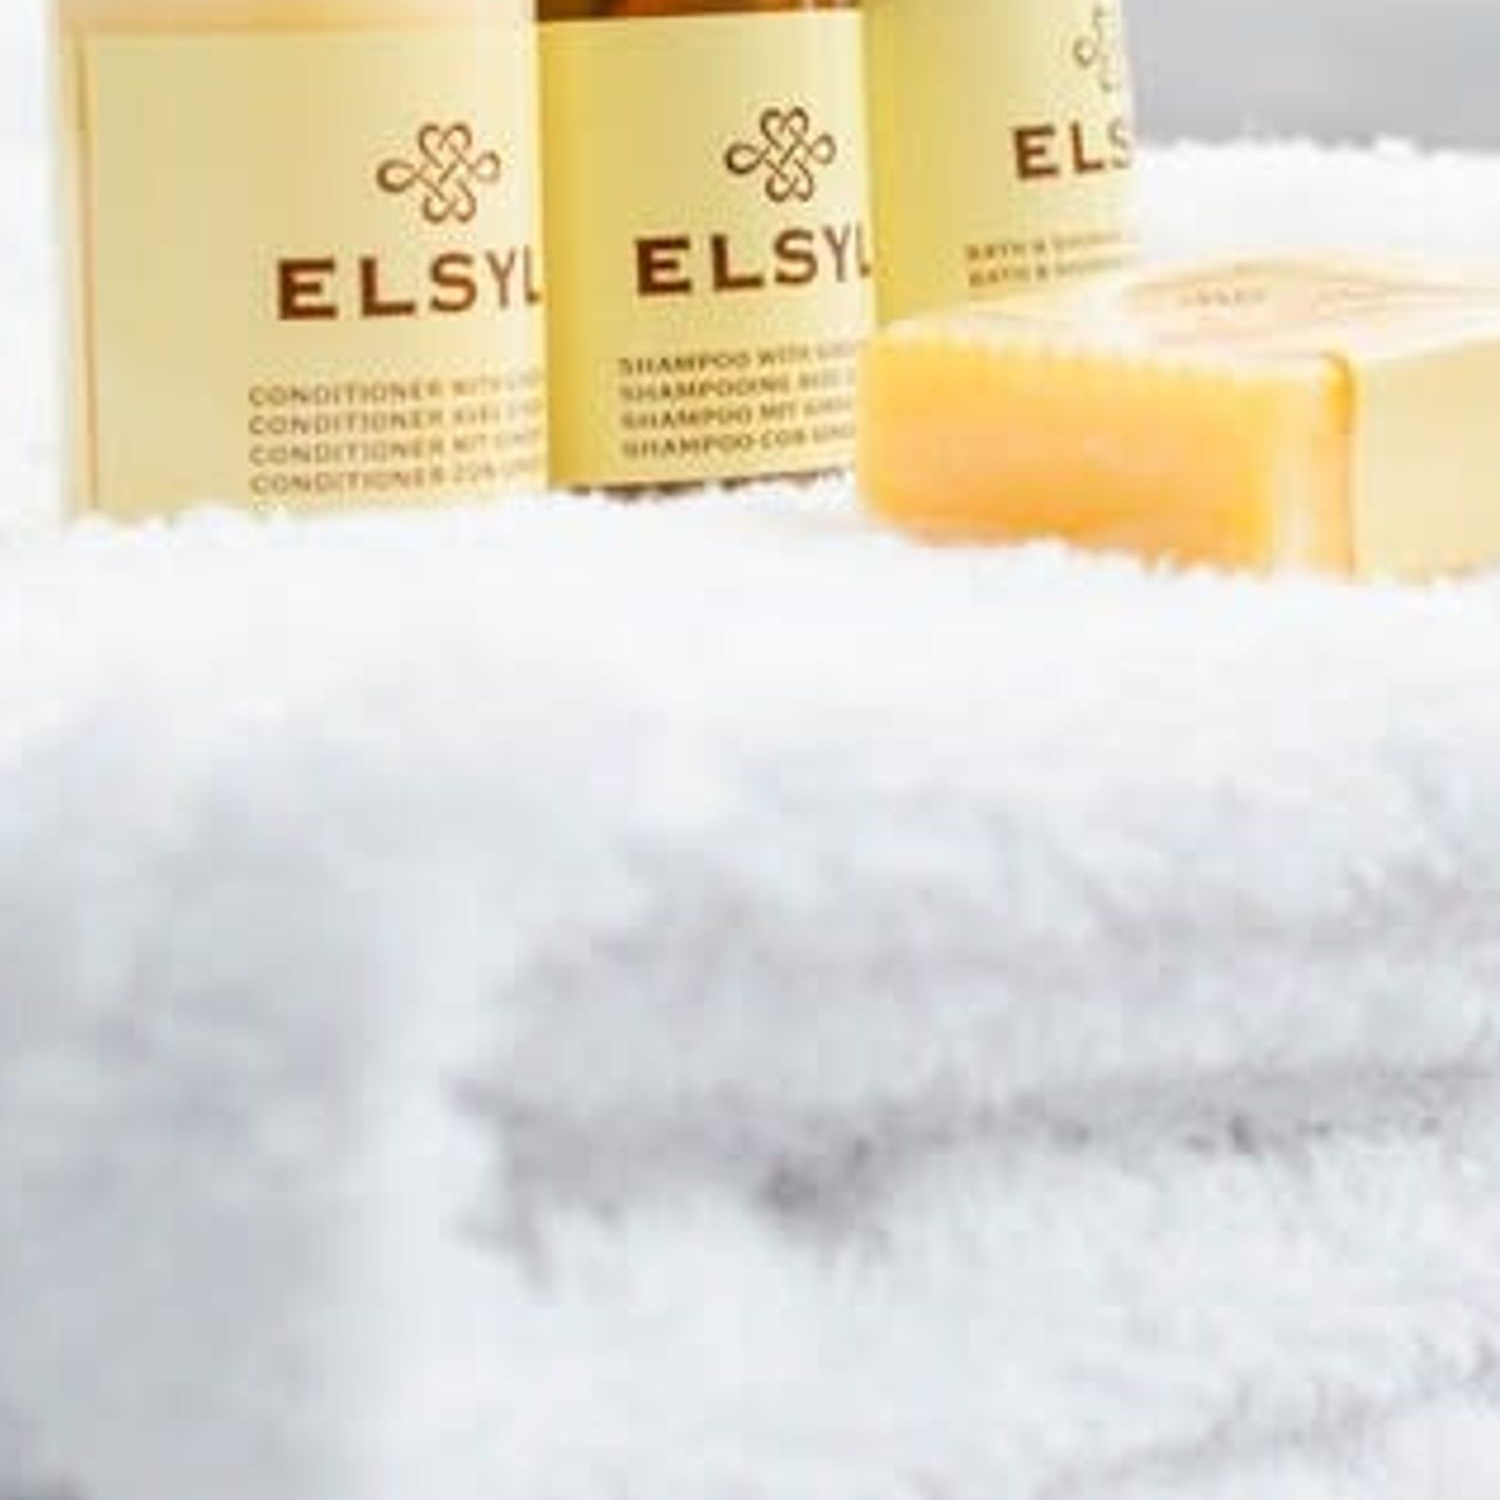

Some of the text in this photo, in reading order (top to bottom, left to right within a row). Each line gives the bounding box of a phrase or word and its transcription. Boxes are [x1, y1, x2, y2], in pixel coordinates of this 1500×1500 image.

[276, 246, 542, 321] ELSYL
[618, 350, 751, 376] SHAMPOO
[248, 379, 443, 408] CONDITIONER
[619, 375, 790, 402] SHAMPOOING
[248, 409, 444, 436] CONDITIONER
[620, 404, 753, 430] SHAMPOO
[760, 401, 797, 422] MIT
[248, 438, 444, 467] CONDITIONER
[621, 433, 754, 459] SHAMPOO
[761, 428, 807, 451] CON
[249, 466, 445, 496] CONDITIONER
